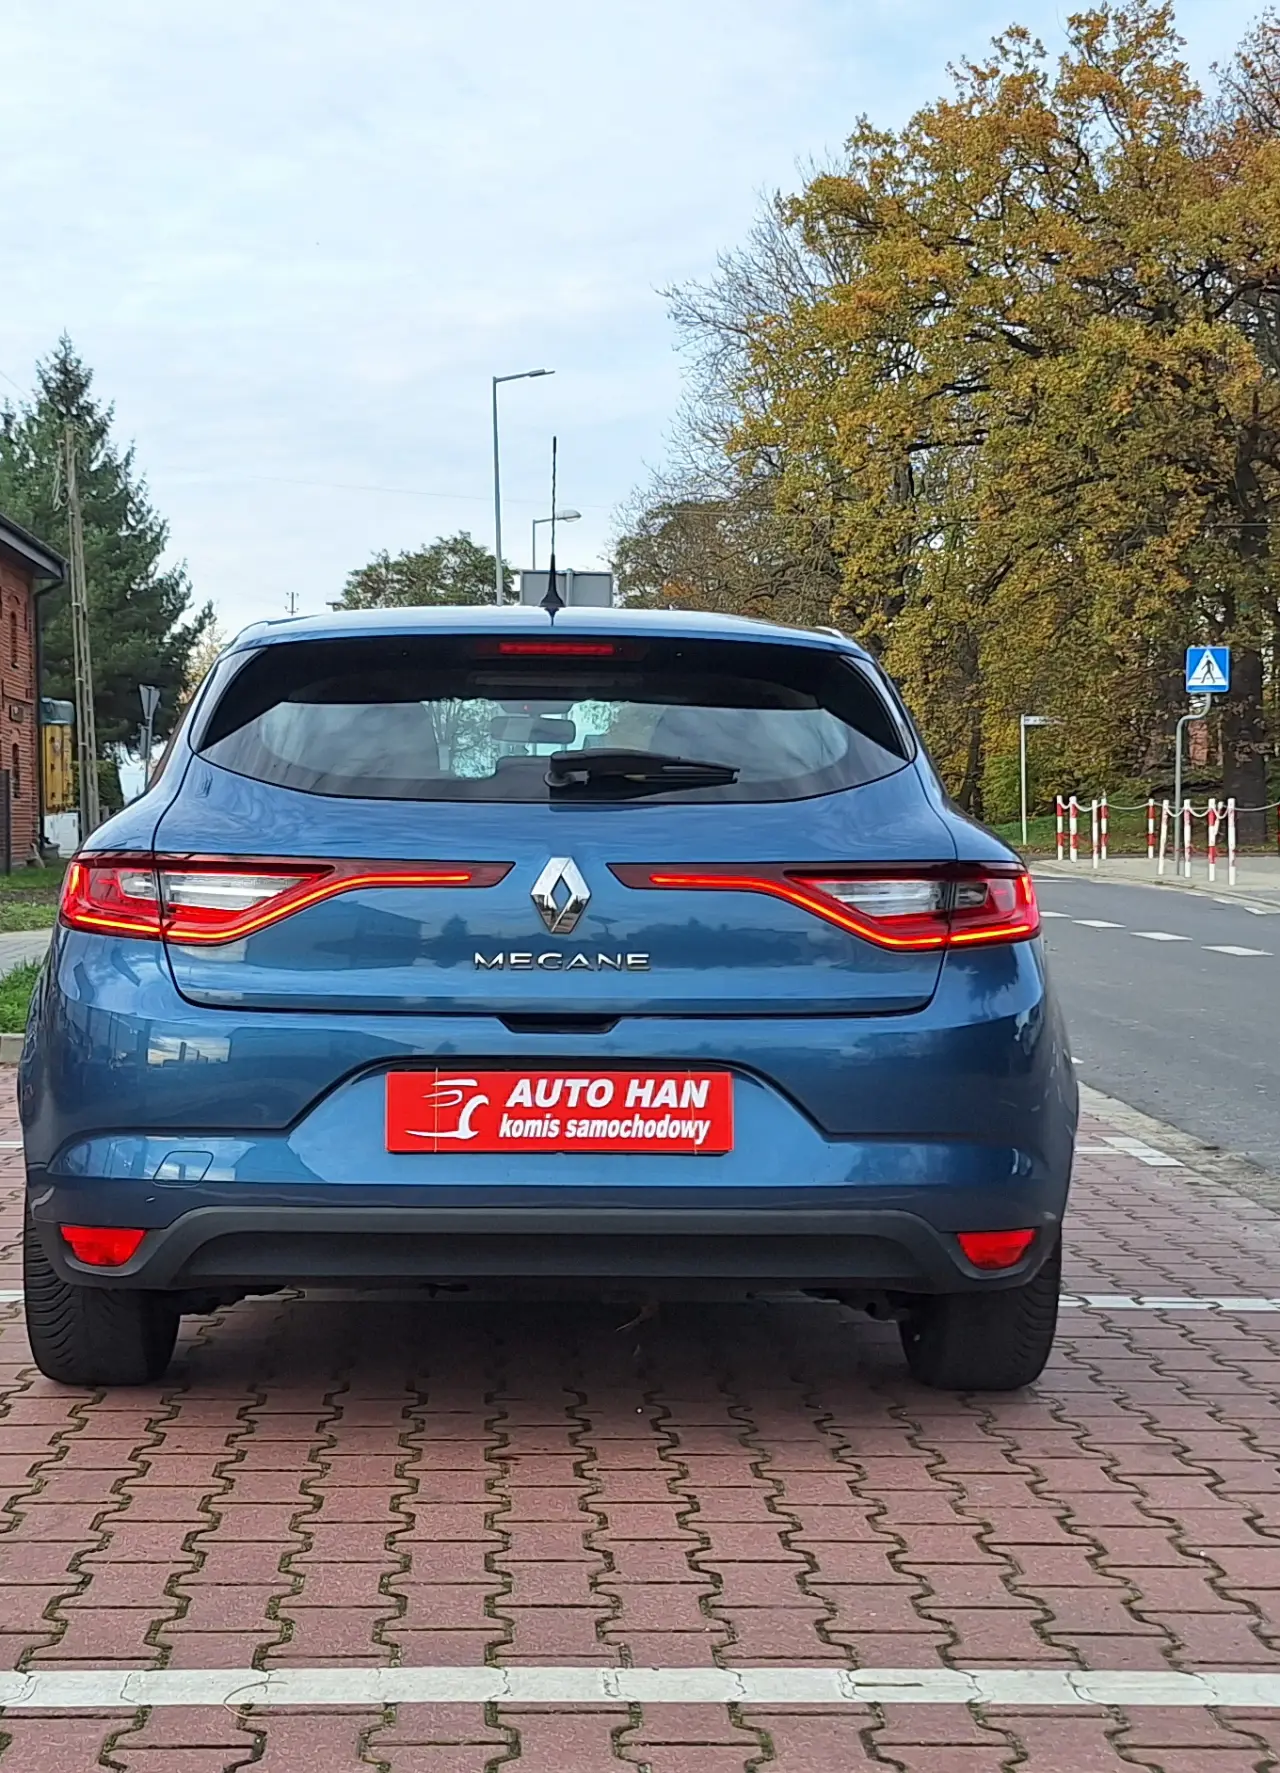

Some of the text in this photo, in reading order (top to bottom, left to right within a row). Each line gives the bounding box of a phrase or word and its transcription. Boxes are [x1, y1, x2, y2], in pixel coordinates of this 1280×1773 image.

[474, 952, 651, 971] MEGANE
[505, 1078, 710, 1109] AUTO HAN
[498, 1112, 711, 1145] komis samochodowy
